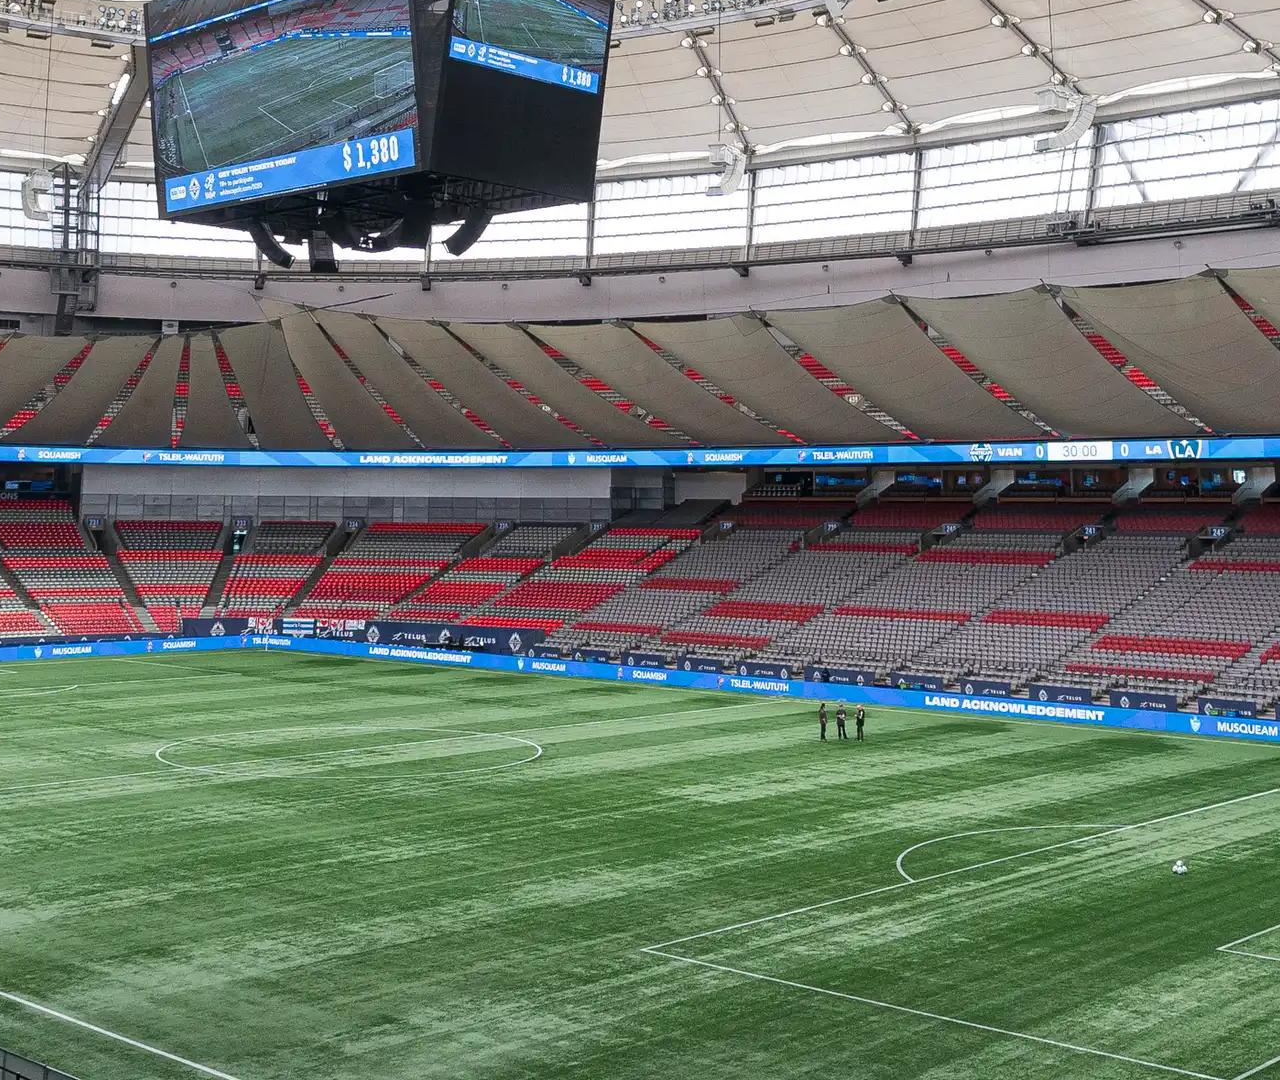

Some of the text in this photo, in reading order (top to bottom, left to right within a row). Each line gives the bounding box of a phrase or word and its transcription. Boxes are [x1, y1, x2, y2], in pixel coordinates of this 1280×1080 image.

[342, 135, 399, 172] $ 1,380
[38, 451, 82, 460] SQUAMISH
[813, 450, 873, 461] TSLEIL-WAUTUTH
[997, 447, 1022, 457] VAN
[1035, 443, 1044, 459] 0
[1119, 443, 1128, 458] 0
[1145, 445, 1162, 455] LA
[1175, 445, 1196, 459] LA
[159, 453, 224, 462] TSLEIL-WAUTUTH
[359, 455, 508, 464] LAND ACKNOWLEDGEMENT
[586, 455, 627, 463] MUSQUEAM
[704, 453, 743, 462] SQUAMISH
[332, 630, 353, 638] TELUS
[403, 633, 426, 641] TELUS
[163, 641, 196, 650] SQUAMISH
[52, 646, 92, 655] MUSQUEAM
[369, 647, 472, 663] LAND ACKNOWLEDGEMENT
[531, 661, 567, 671] MUSQUEAM
[632, 671, 668, 681] SQUAMISH
[730, 679, 789, 692] TSLEIL-WAUTUTH
[925, 696, 1105, 721] LAND ACKNOWLEDGEMENT
[1149, 701, 1167, 709] TELUS
[1217, 721, 1278, 736] MUSQUEAM
